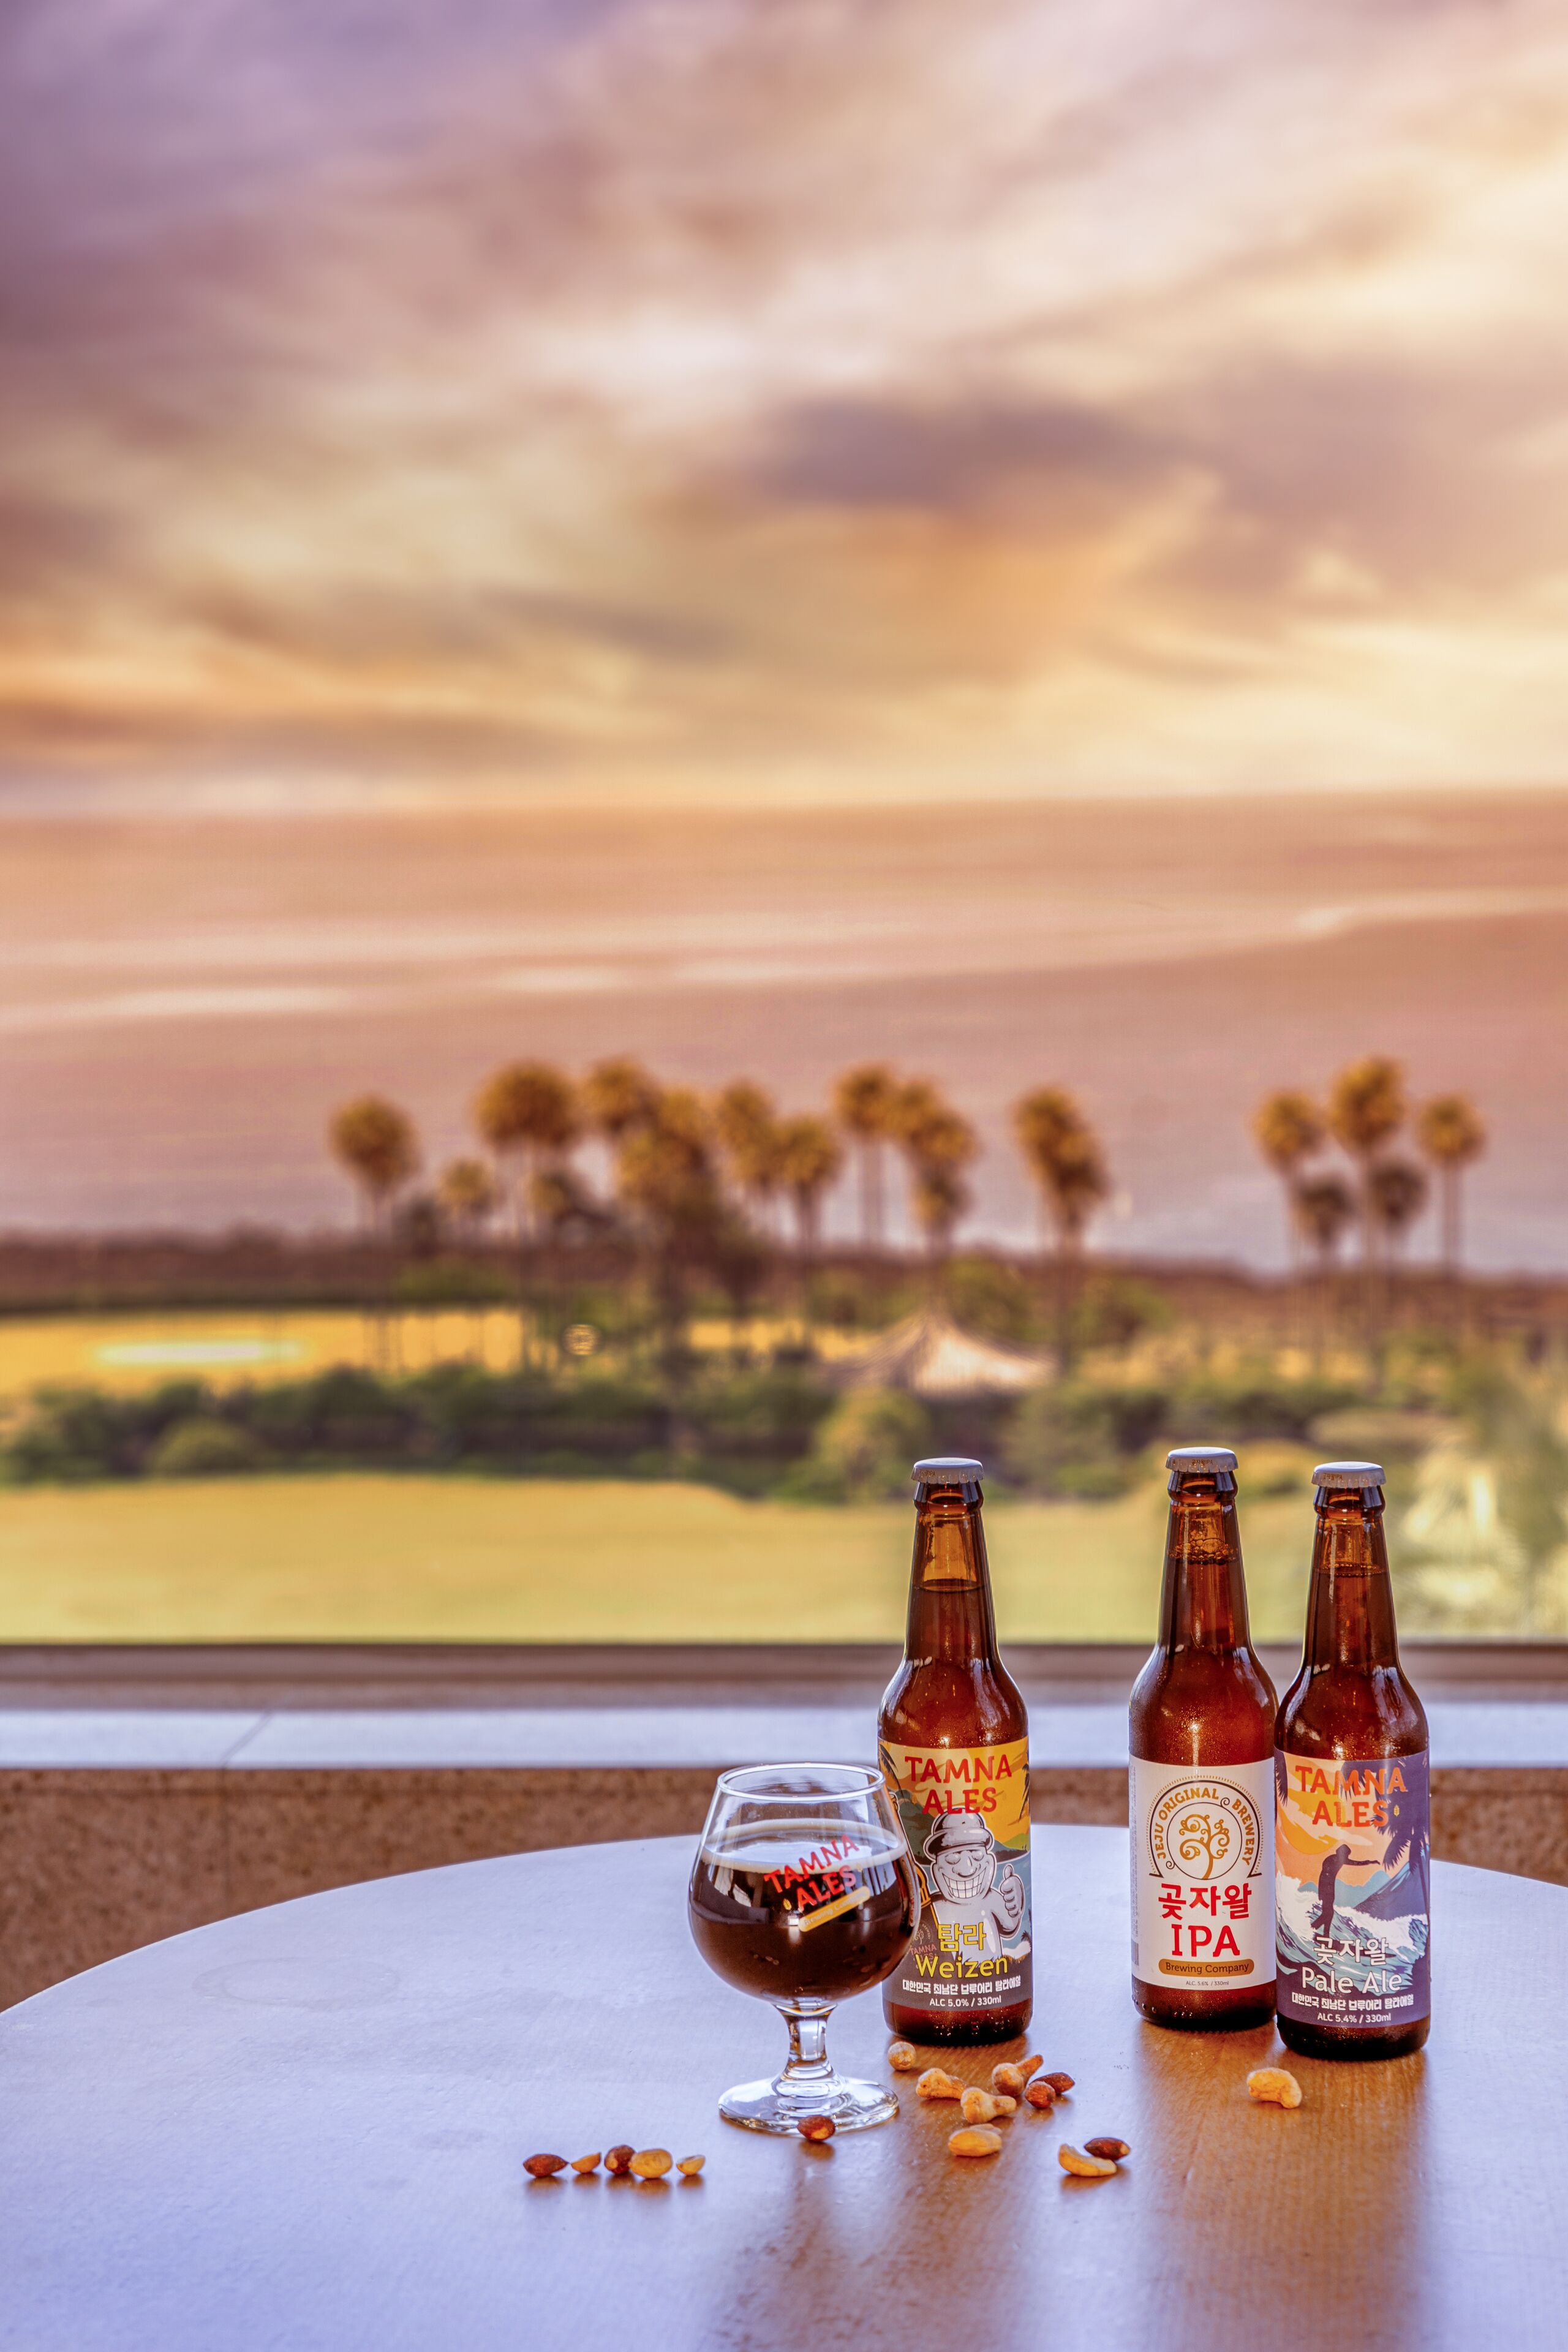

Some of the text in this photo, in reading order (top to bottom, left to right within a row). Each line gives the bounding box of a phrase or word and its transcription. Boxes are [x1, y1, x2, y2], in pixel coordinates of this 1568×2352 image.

[905, 1754, 1012, 1784] TAMNA
[1295, 1765, 1408, 1795] TAMNA
[922, 1787, 997, 1815] ALES
[1312, 1800, 1389, 1827] ALES
[1154, 1787, 1255, 1866] JEJU ORIGINAL BREWERY
[764, 1834, 859, 1893] TAMNA
[797, 1865, 856, 1912] ALES
[1158, 1883, 1252, 1920] 곶자왈
[910, 1943, 937, 1955] TAMNA
[938, 1921, 987, 1952] 탐라
[1171, 1924, 1240, 1957] IPA
[1313, 1936, 1389, 1966] 곶자왈
[914, 1954, 1008, 1978] Weizen
[1166, 1962, 1250, 1975] Brewing Company
[1302, 1966, 1402, 1994] Pale Ale
[902, 1975, 1021, 1996] 대한민국 최남단 브루어리 탐라에일
[929, 1995, 1001, 2007] ALC 5.0% / 330ml
[1291, 1992, 1414, 2011] 대한민국 최남단 브루어리 탐라에일
[1317, 2013, 1392, 2024] ALC 5.4% / 330ml
